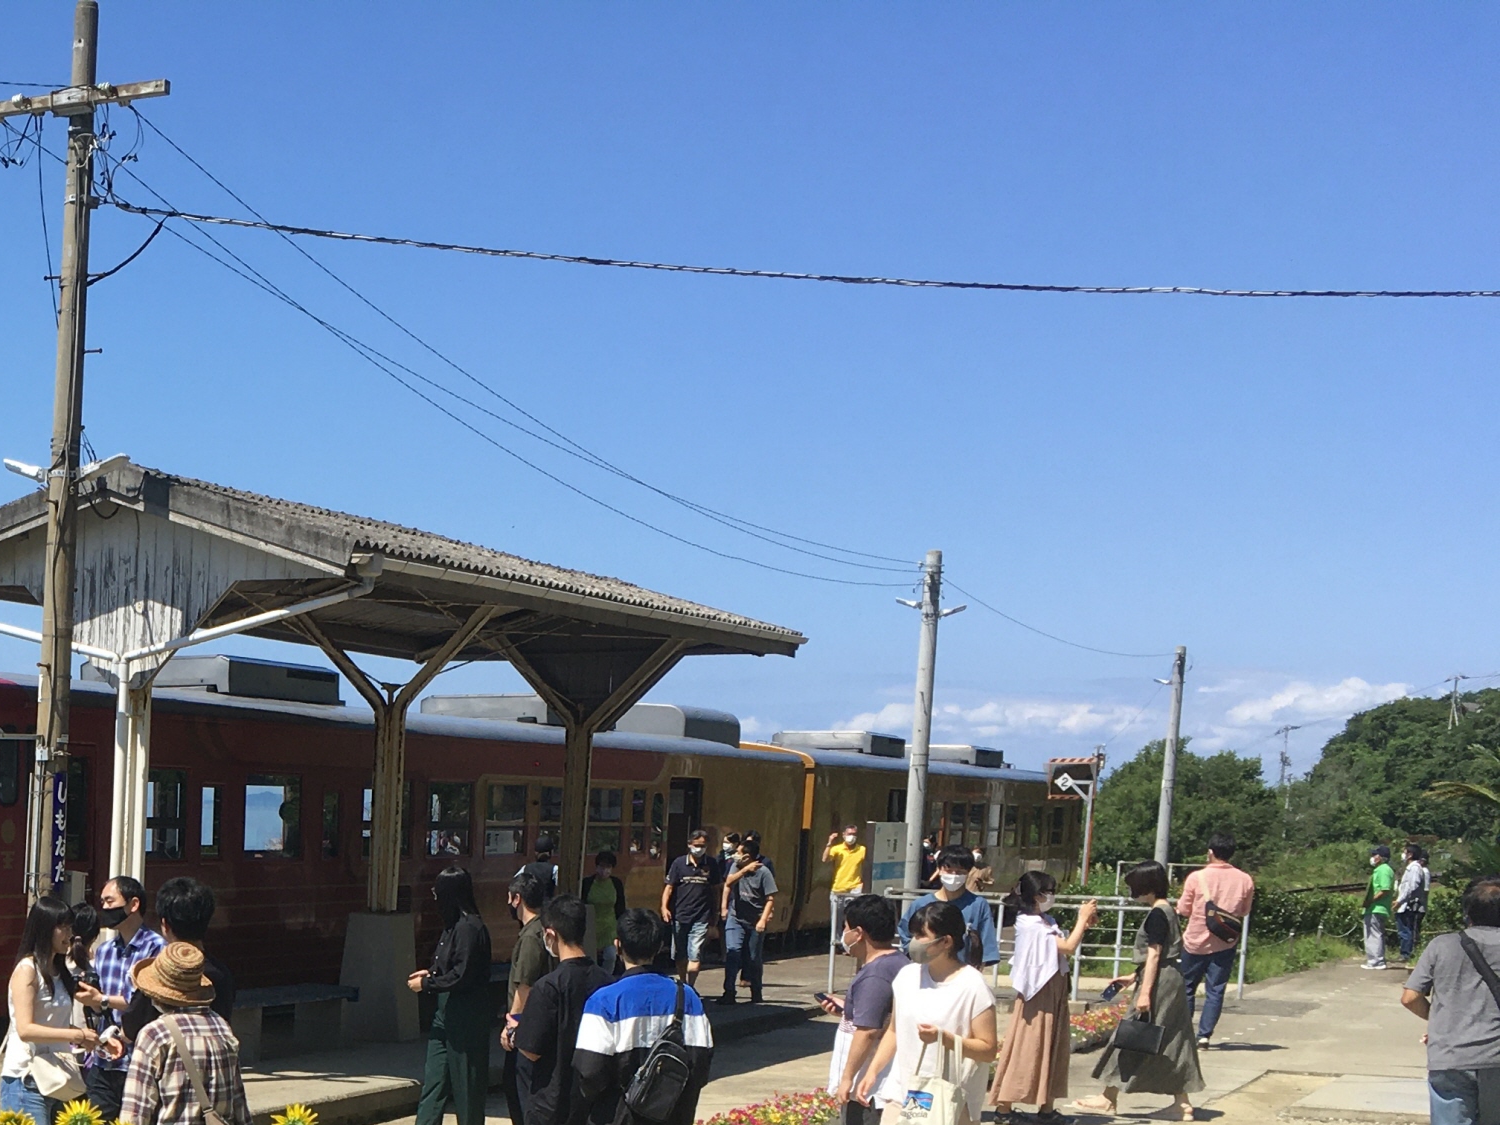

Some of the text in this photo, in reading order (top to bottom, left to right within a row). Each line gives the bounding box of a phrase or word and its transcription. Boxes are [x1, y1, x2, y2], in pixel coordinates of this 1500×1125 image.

[1061, 777, 1069, 787] 2
[54, 781, 67, 883] しもなだ
